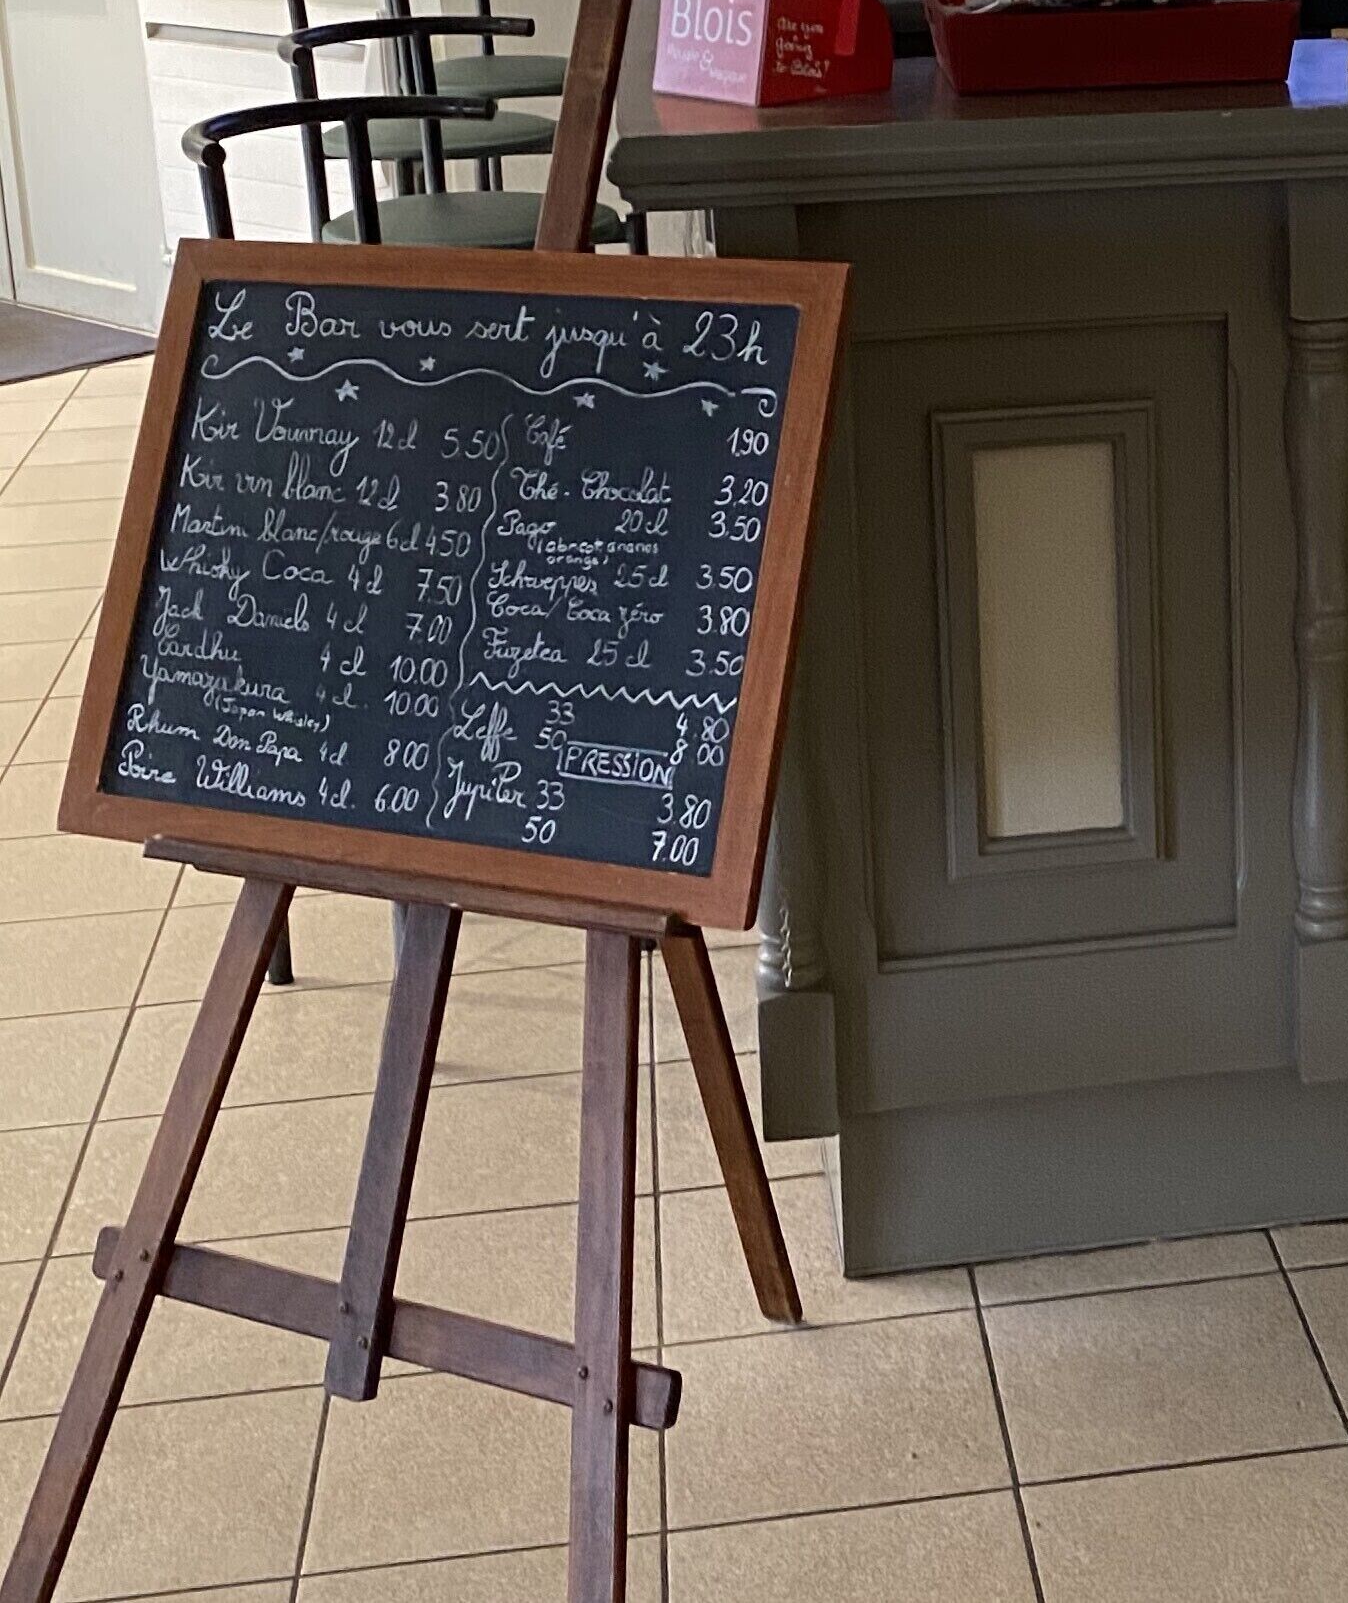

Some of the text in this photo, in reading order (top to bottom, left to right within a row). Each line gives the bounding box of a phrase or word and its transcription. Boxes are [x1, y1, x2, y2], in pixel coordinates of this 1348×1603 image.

[208, 287, 769, 379] Le Bar vous sert jusqu'à 23h
[191, 396, 241, 443] Kir
[524, 412, 770, 466] Café 1.90
[179, 453, 225, 491] Kir
[281, 449, 347, 504] blanc
[509, 466, 560, 501] Thé
[580, 465, 673, 504] Chocolat
[713, 474, 769, 507] 3.20
[170, 502, 249, 538] Martini
[708, 509, 762, 543] 3.50
[262, 548, 335, 585] Coca
[695, 563, 754, 594] 3.50
[152, 584, 204, 638] Jack
[226, 592, 310, 633] Daniels
[696, 604, 751, 638] 3.80
[158, 622, 242, 662] Cardhu
[389, 654, 449, 688] 10.00
[685, 648, 746, 678] 3.50
[126, 702, 201, 741] Rhum
[212, 723, 252, 751] Don
[255, 729, 304, 767] Papa
[453, 698, 518, 762] Leffe
[545, 699, 576, 726] 33
[533, 726, 568, 751] 50
[117, 738, 178, 785] Poire
[195, 753, 307, 807] Williams
[565, 746, 674, 785] PRESSION
[536, 778, 566, 811] 33
[521, 815, 700, 866] 50 7.00
